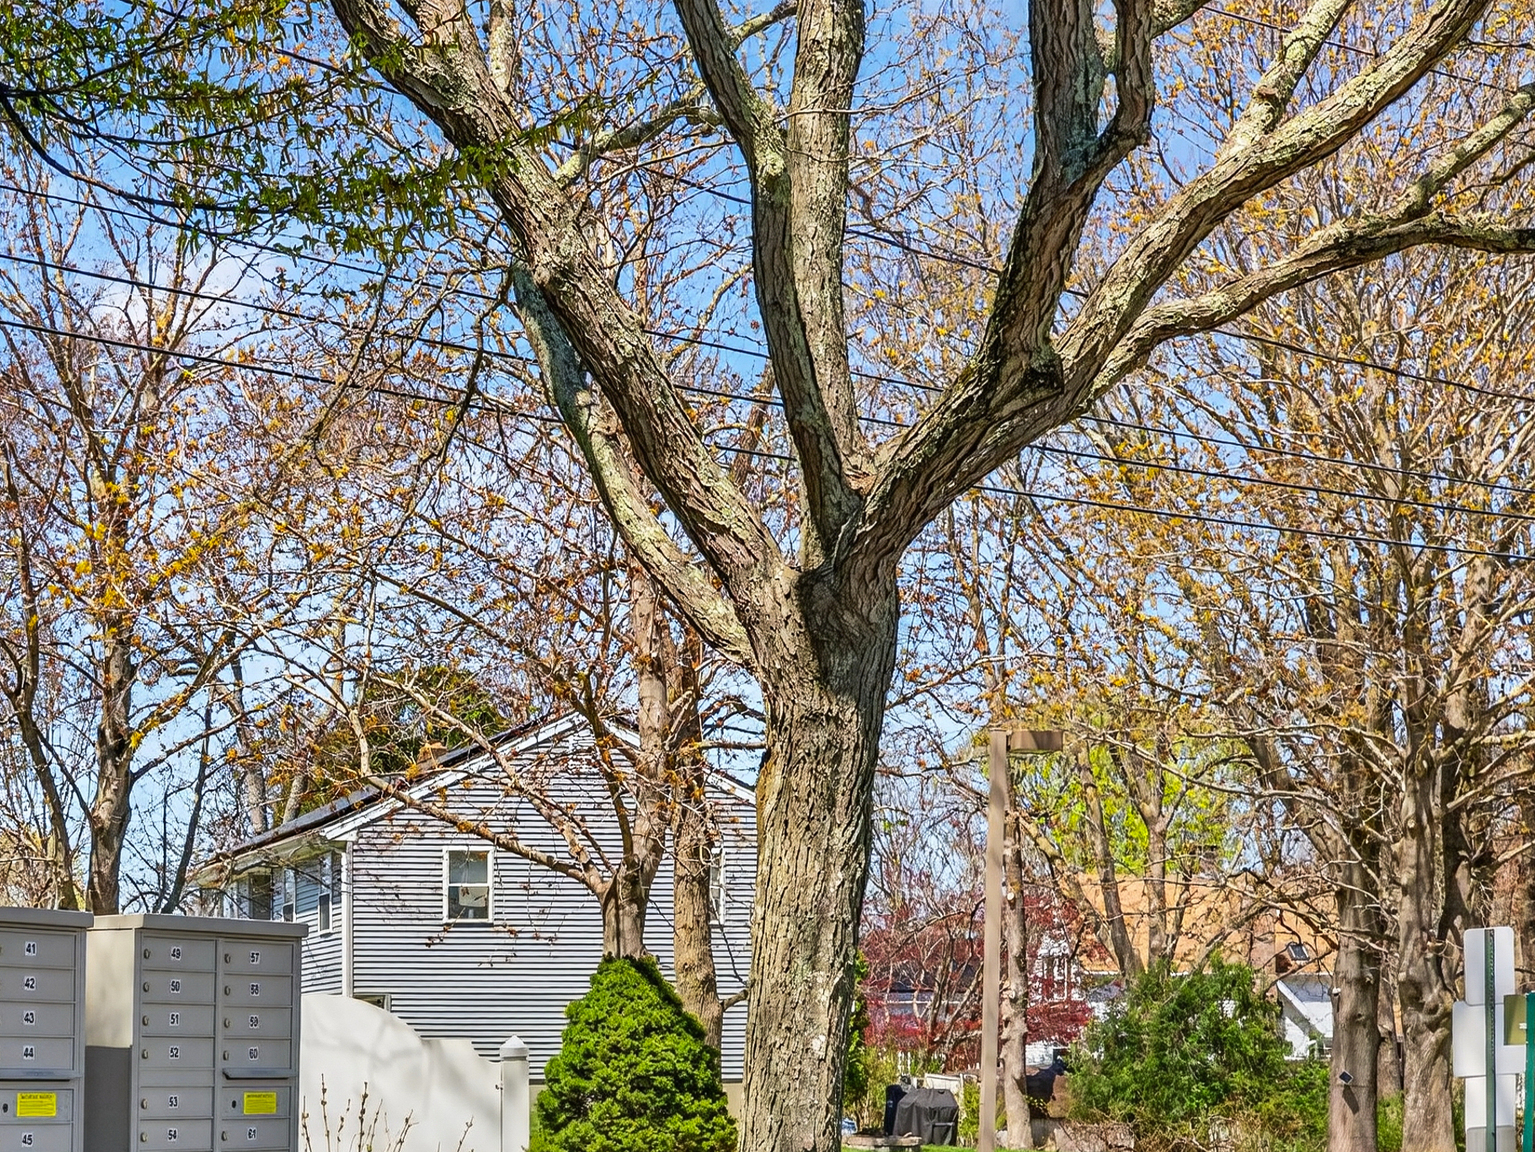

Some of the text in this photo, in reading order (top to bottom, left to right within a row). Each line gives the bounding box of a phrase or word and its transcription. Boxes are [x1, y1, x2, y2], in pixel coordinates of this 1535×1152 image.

[25, 943, 36, 954] 41
[250, 952, 260, 963] 57
[24, 977, 35, 989] 42
[170, 980, 181, 992] 50
[23, 1012, 35, 1024] 43
[170, 1013, 179, 1025] 51
[23, 1047, 34, 1058] 44
[170, 1047, 179, 1058] 52
[249, 1048, 258, 1059] 60
[169, 1096, 178, 1107] 53
[21, 1134, 33, 1146] 45
